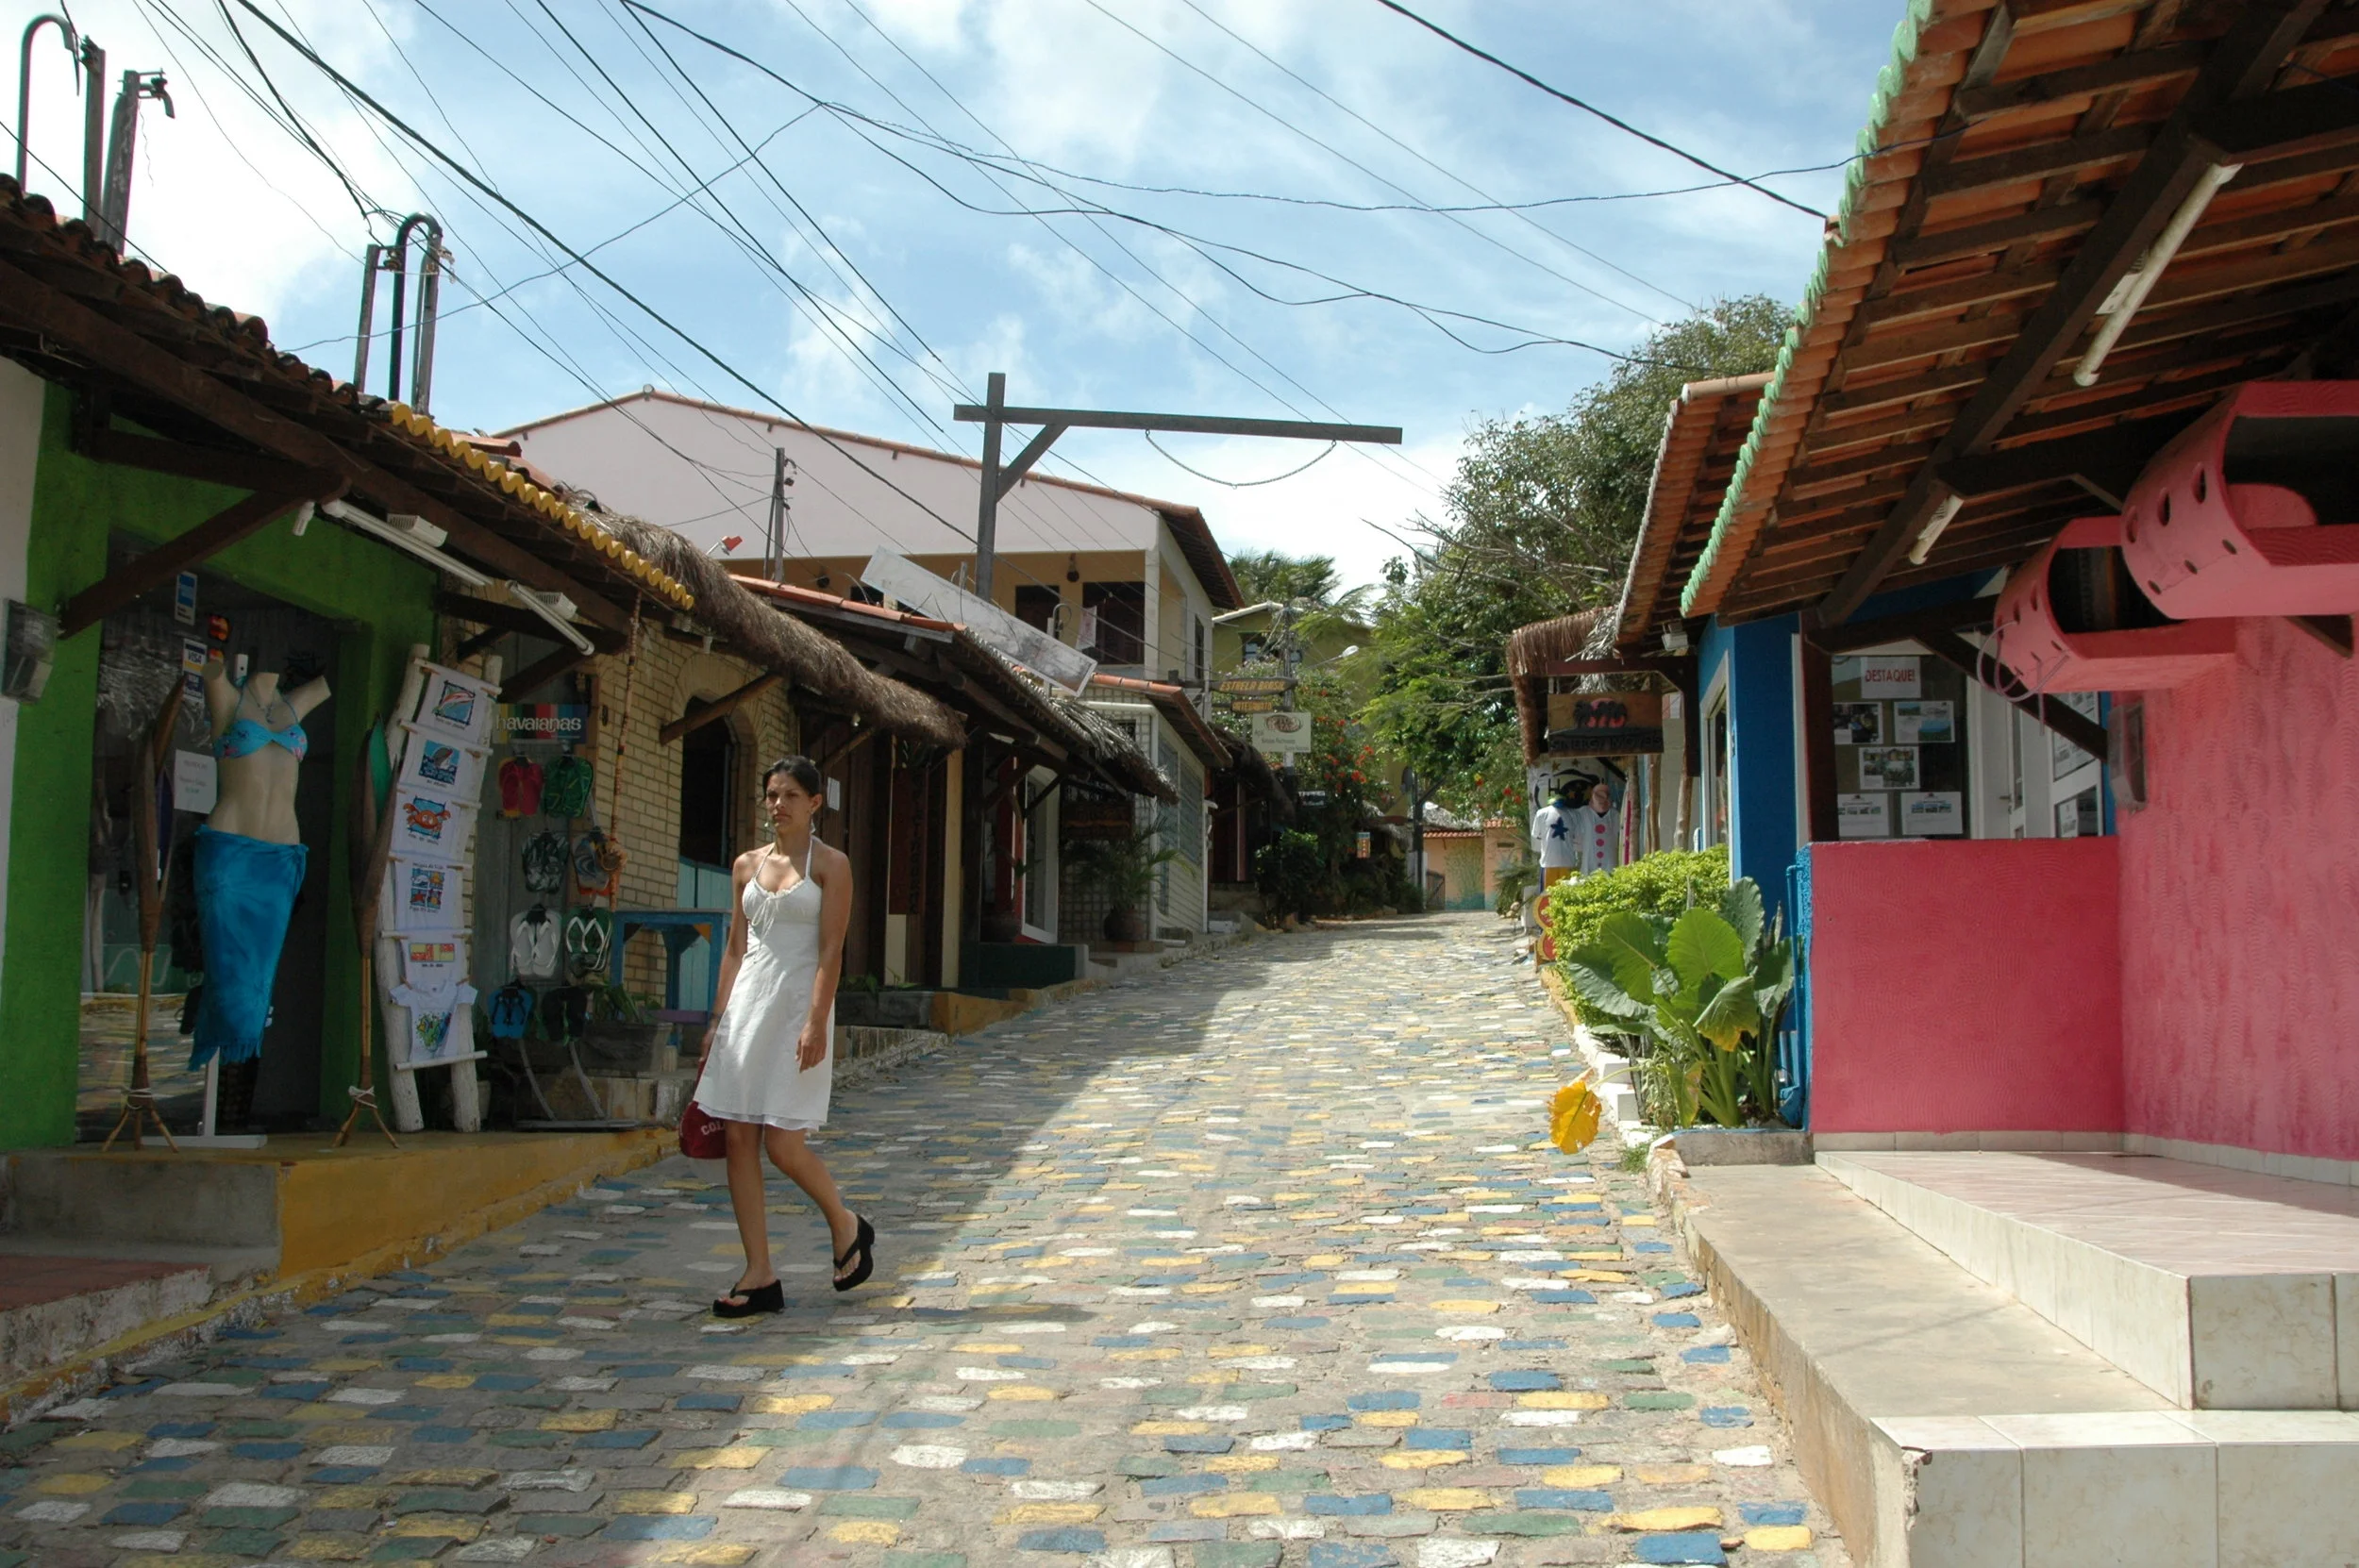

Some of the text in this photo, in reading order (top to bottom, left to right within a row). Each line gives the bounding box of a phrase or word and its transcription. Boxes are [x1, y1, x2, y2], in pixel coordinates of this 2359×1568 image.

[188, 651, 202, 664] VISA
[1865, 668, 1916, 683] DESTAQUE!
[495, 714, 582, 732] havaianas
